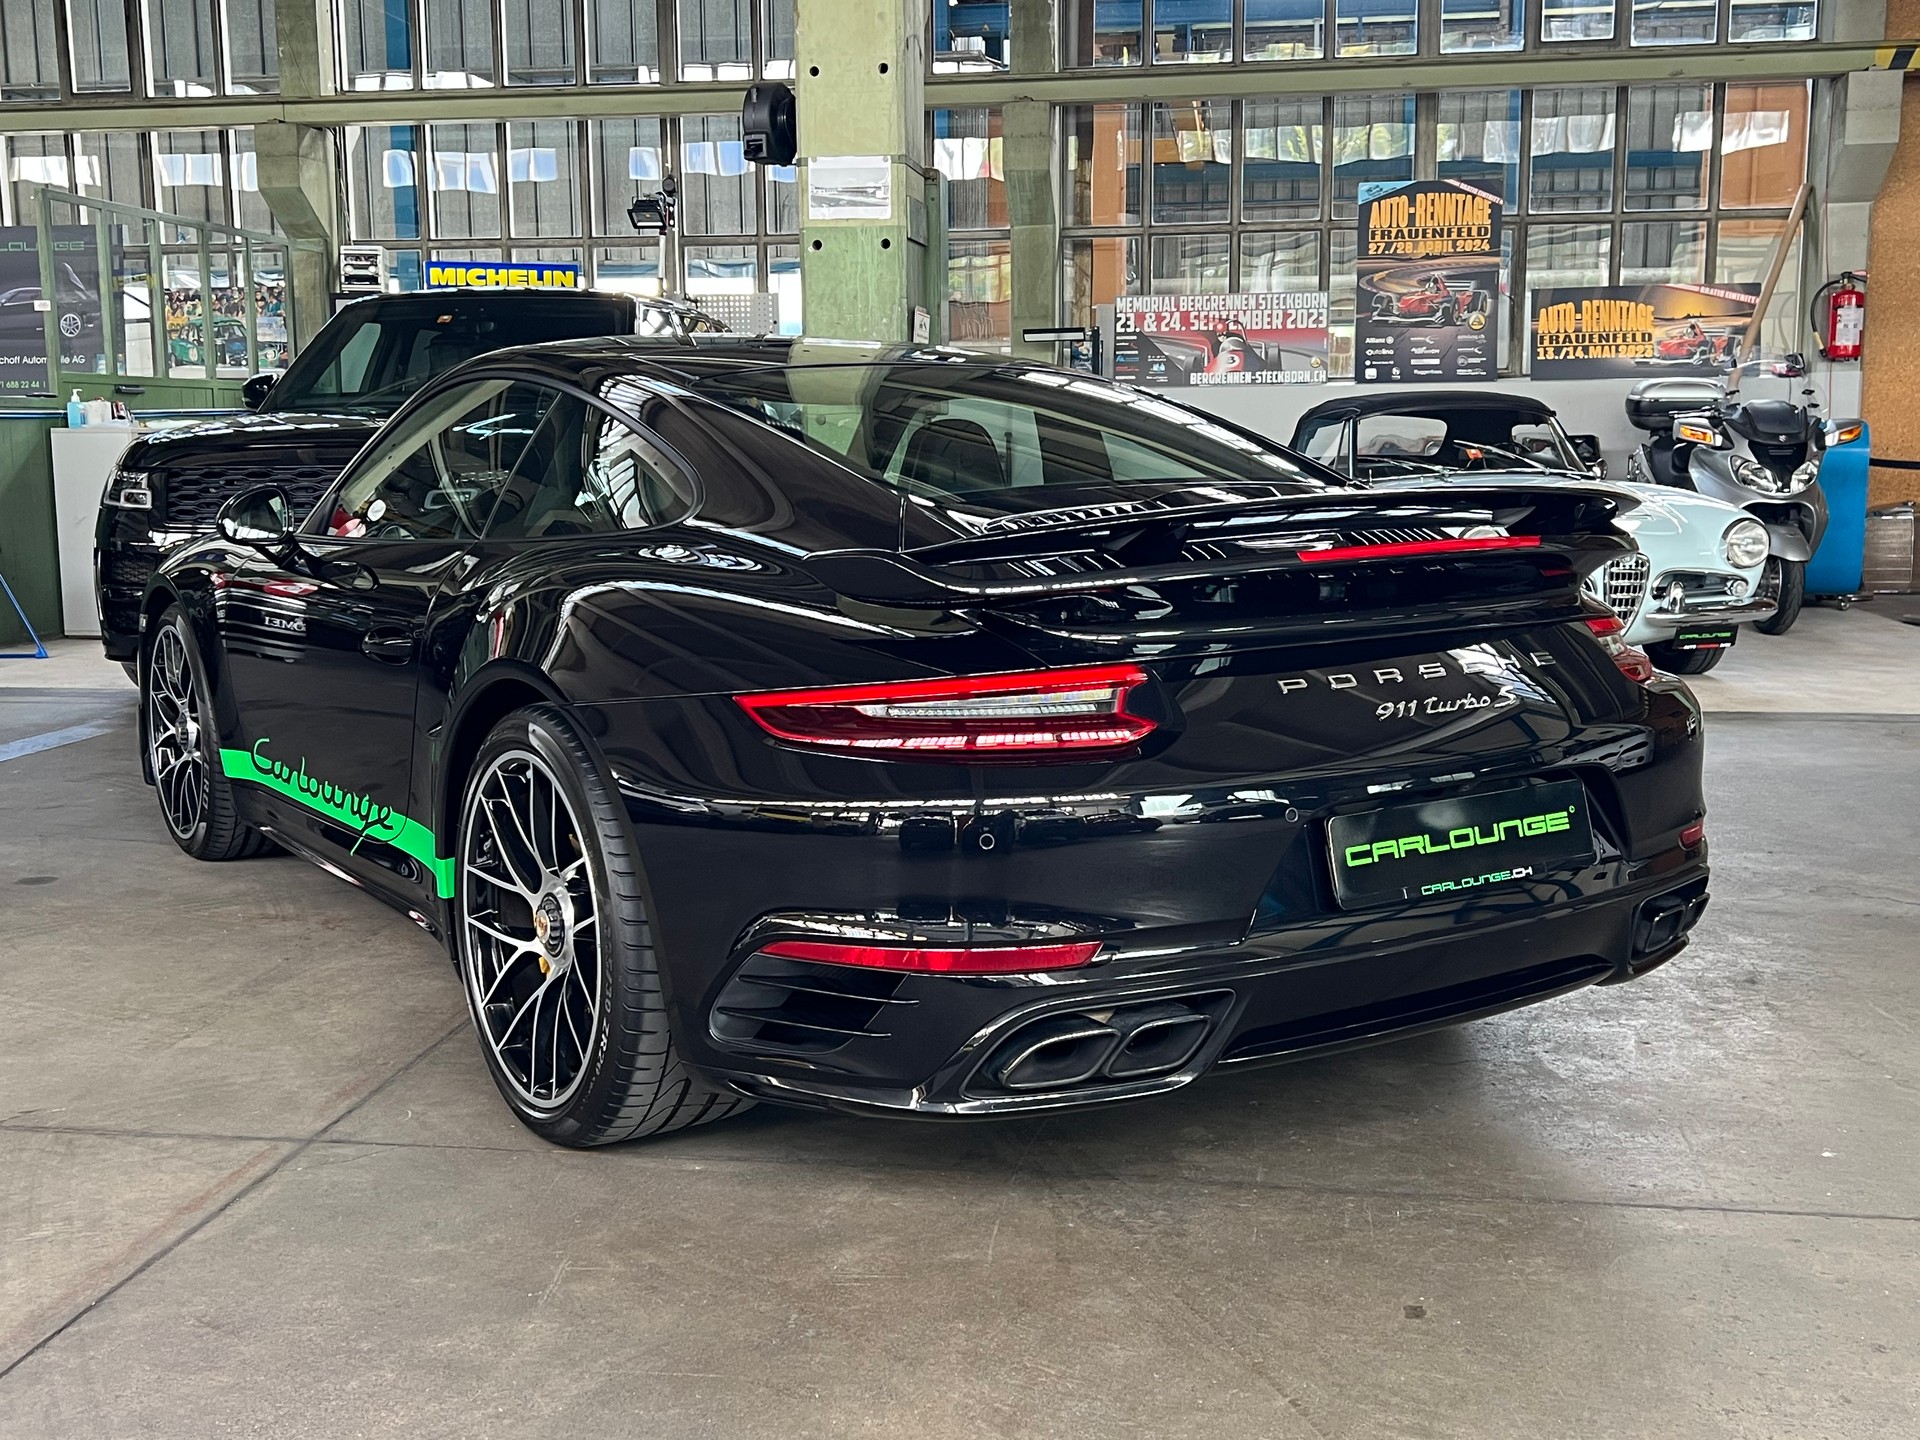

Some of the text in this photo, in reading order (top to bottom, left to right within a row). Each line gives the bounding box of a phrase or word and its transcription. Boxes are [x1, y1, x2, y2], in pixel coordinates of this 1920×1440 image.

[1369, 192, 1492, 228] AUTO-RENNTAGE
[1370, 226, 1489, 240] FRAUENFELD
[1456, 239, 1490, 252] 2024
[429, 267, 575, 288] MICHELIN
[1116, 292, 1327, 313] MEMORIAL BERGRENNEN STECKBORN
[1116, 313, 1140, 333] 23.
[1143, 313, 1157, 332] &
[1161, 311, 1186, 332] 24.
[1287, 308, 1327, 329] 2023
[1538, 300, 1654, 333] AUTO-RENNTAGE
[1539, 332, 1652, 345] FRAUENFELD
[71, 355, 86, 364] AG
[1228, 356, 1236, 364] 3
[1619, 344, 1654, 358] 2023
[6, 381, 20, 389] 688
[20, 381, 29, 389] 22
[31, 380, 40, 389] 44
[1190, 369, 1327, 385] BERGRENNEN-STECKBORN.CH
[1277, 652, 1557, 695] PORSCHE
[1376, 685, 1521, 721] 911 Turbo S
[1421, 866, 1533, 896] CARLOUNGE.CH
